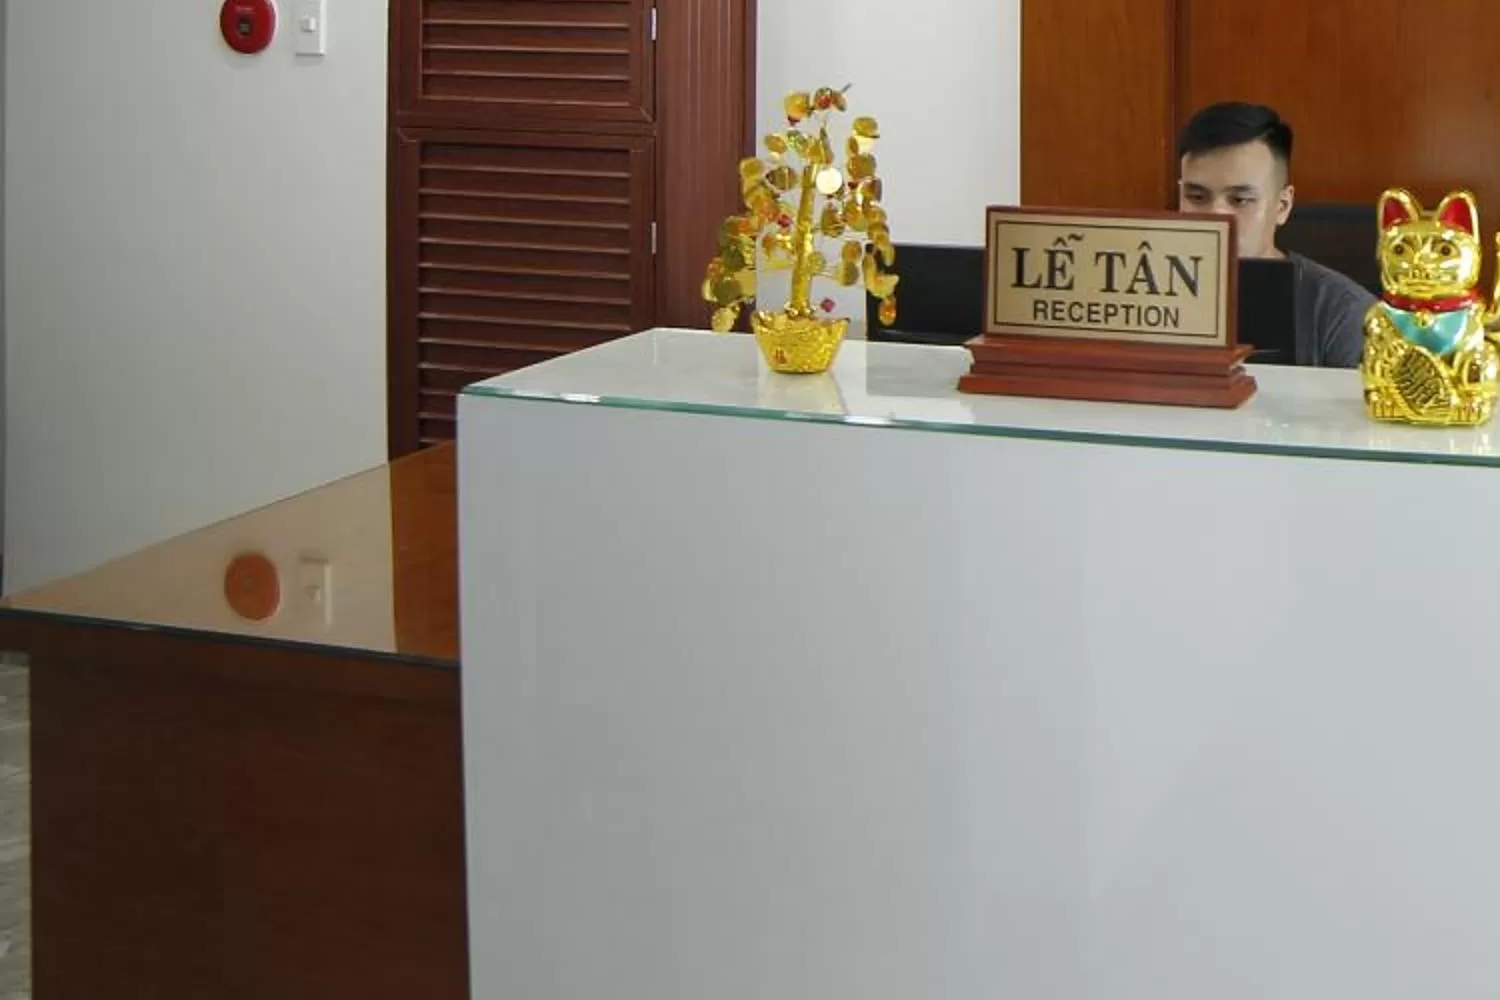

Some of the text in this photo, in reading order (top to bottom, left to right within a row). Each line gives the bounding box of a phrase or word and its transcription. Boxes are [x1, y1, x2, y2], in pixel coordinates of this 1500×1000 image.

[1010, 233, 1203, 297] LỄ TÂN
[1032, 300, 1180, 328] RECEPTION
